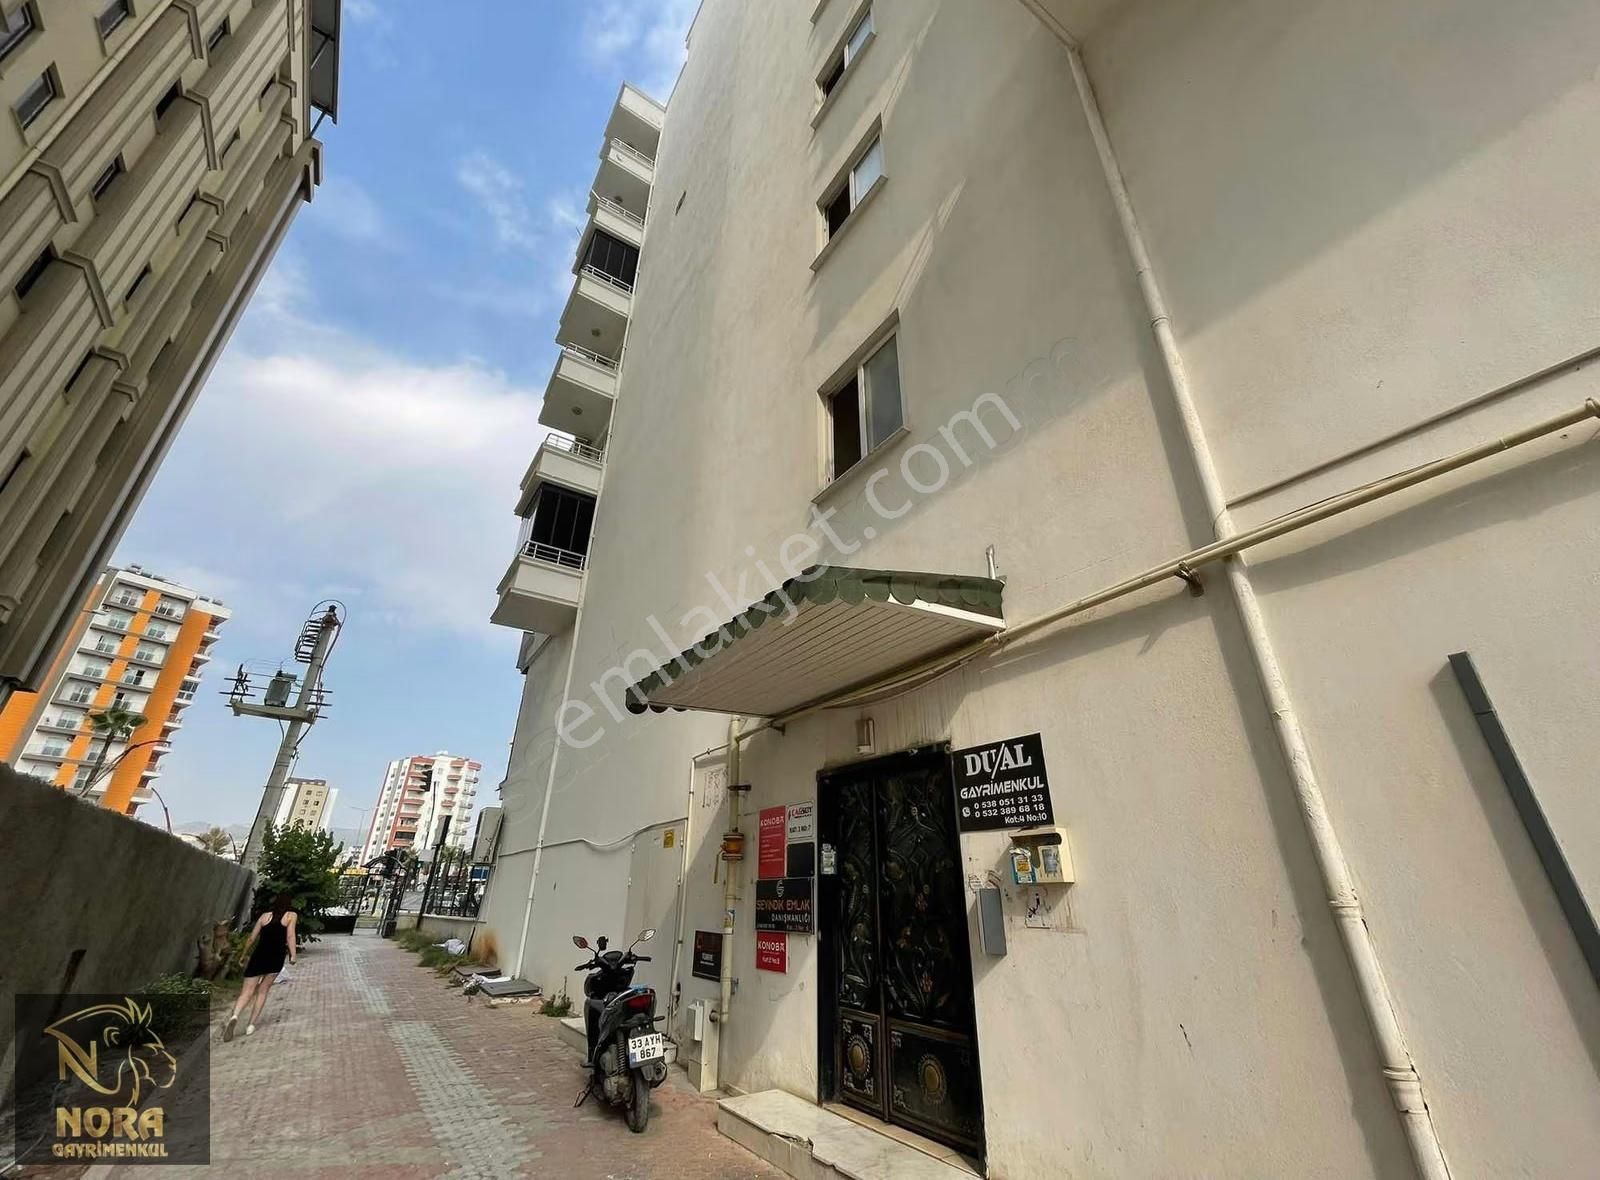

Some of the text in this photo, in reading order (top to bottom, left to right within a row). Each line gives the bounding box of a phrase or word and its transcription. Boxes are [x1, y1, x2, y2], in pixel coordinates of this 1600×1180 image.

[960, 776, 1045, 799] GAYRİMENKUL
[981, 800, 997, 809] 538
[999, 798, 1015, 806] 051
[1017, 795, 1028, 804] 31
[1031, 794, 1044, 802] 33
[982, 809, 998, 817] 532
[1000, 806, 1016, 815] 389
[1018, 804, 1030, 813] 68
[1033, 803, 1045, 811] 18
[1026, 812, 1047, 822] No:10
[786, 899, 810, 910] EMLAK
[631, 1034, 661, 1049] 33 AYH
[640, 1046, 656, 1059] 867
